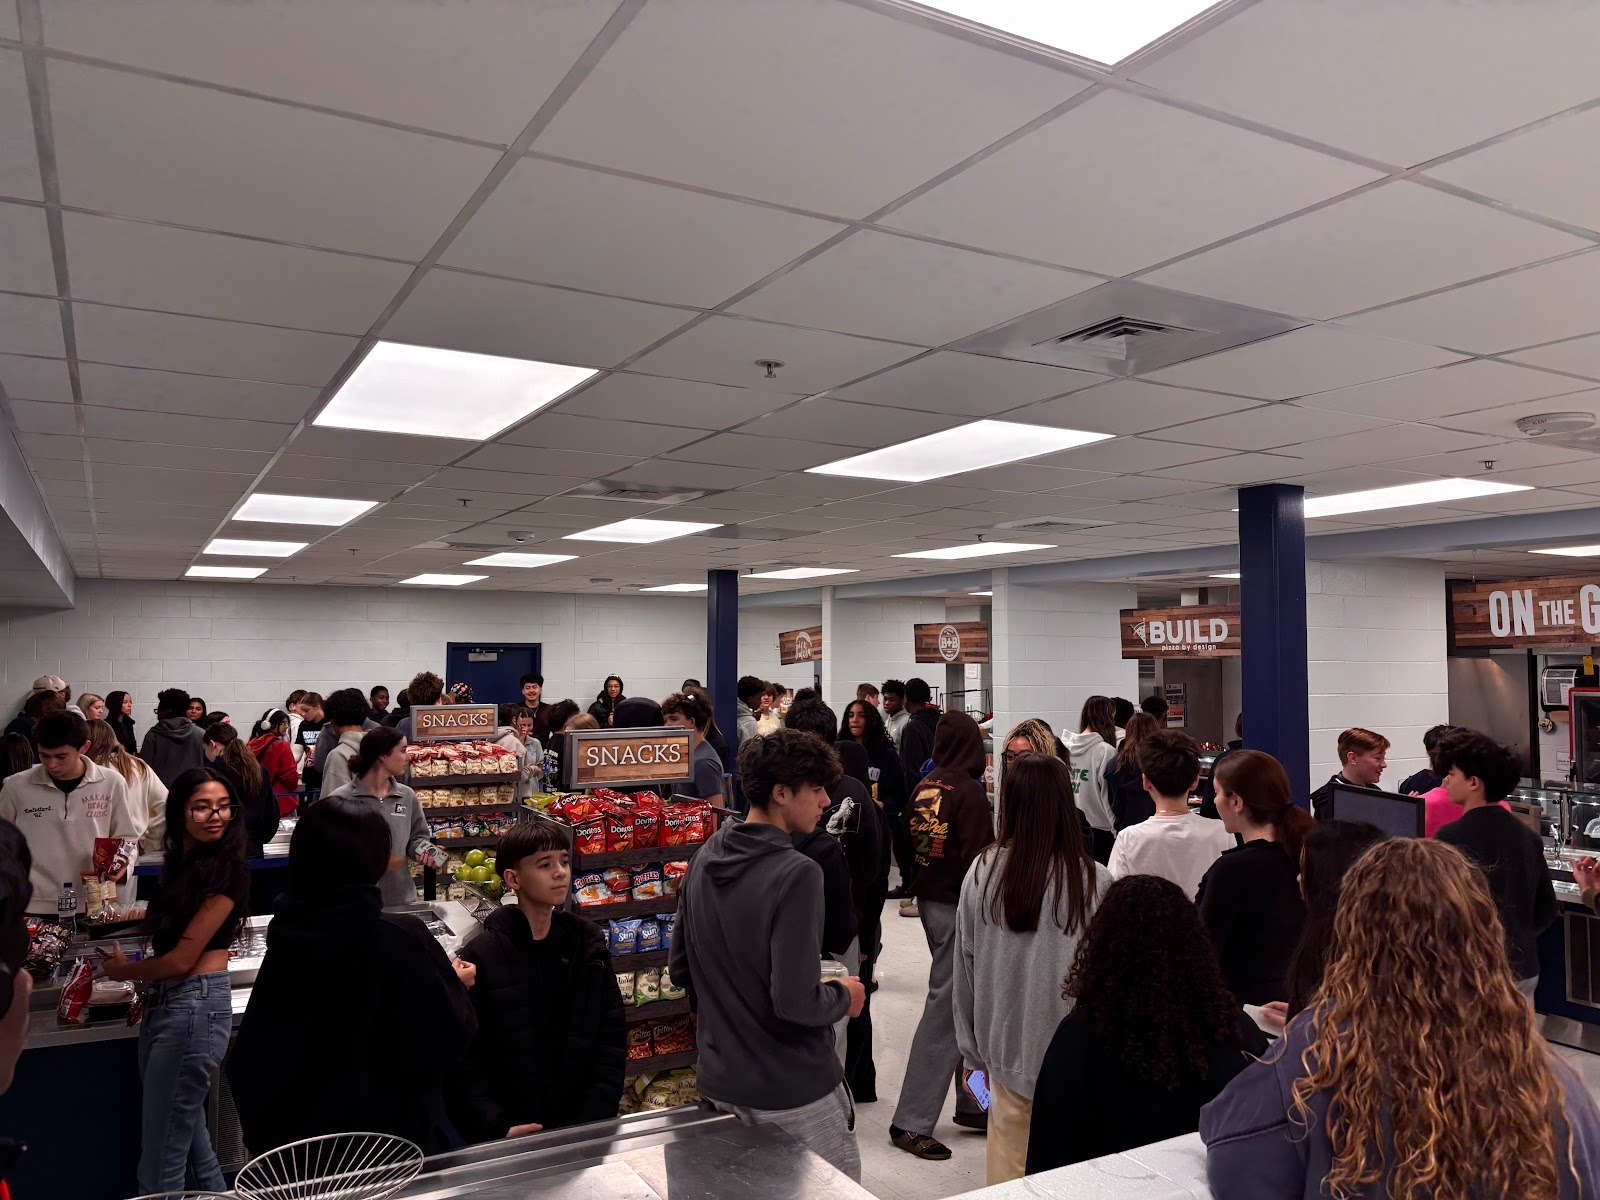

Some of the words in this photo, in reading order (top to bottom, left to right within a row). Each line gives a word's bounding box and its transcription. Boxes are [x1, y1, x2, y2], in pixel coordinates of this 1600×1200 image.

[1488, 590, 1535, 637] ON
[1538, 599, 1575, 626] THE
[1579, 584, 1600, 635] G
[1149, 618, 1229, 644] BUILD
[941, 636, 958, 648] B+B
[1161, 644, 1180, 652] pizza
[1181, 644, 1191, 652] by
[1192, 643, 1217, 652] design
[422, 713, 488, 728] SNACKS
[586, 743, 681, 767] SNACKS
[81, 793, 112, 805] MAKAH
[87, 802, 109, 810] BEACH
[85, 810, 108, 818] CLASSIC
[576, 826, 602, 837] Doritos
[574, 873, 601, 890] RUFFLES
[633, 871, 660, 886] RUFFLES
[618, 931, 635, 942] Sun
[642, 928, 658, 940] Sun
